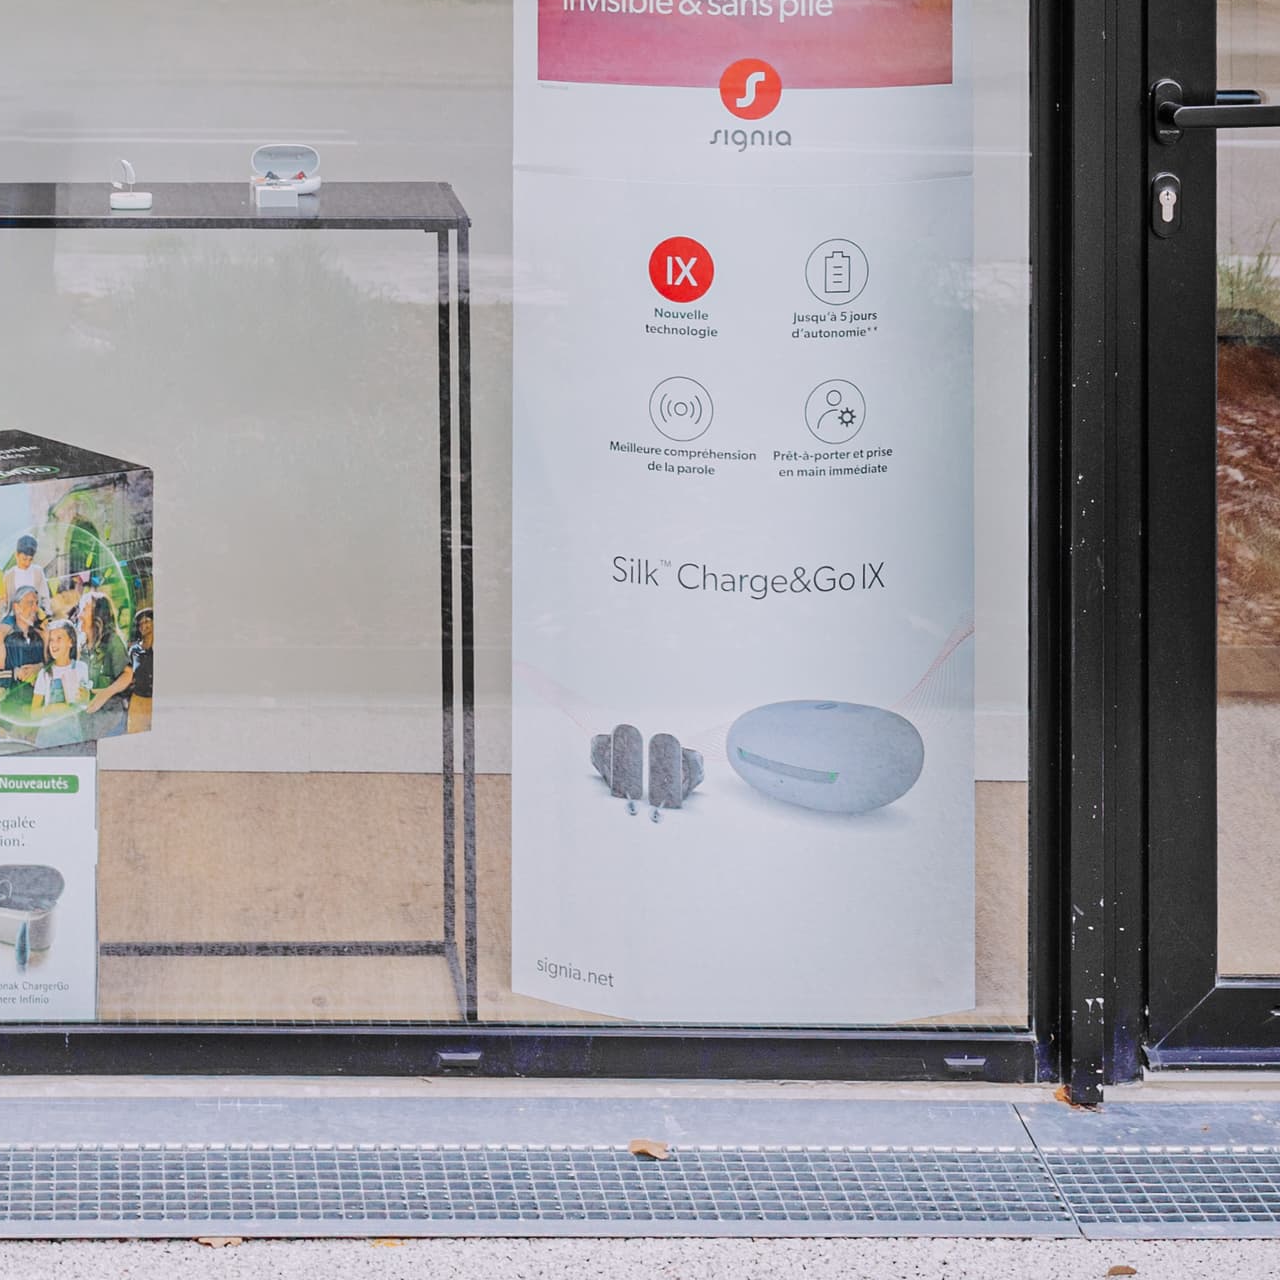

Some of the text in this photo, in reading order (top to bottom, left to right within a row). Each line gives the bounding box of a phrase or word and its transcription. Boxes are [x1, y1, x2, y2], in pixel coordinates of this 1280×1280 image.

[709, 127, 793, 152] signia
[666, 255, 698, 287] IX
[654, 306, 709, 322] Nouvelle
[839, 311, 847, 323] 5
[848, 309, 878, 325] jours
[645, 323, 718, 340] technologie
[609, 440, 757, 464] Meilleure compréhension
[773, 445, 893, 463] Prêt-à-porter et prise
[647, 461, 716, 478] de la parole
[778, 463, 888, 478] en main immédiate
[860, 560, 886, 591] IX
[536, 956, 615, 988] signia.net
[22, 980, 70, 993] ChargerGo
[19, 993, 50, 1005] Infinio
